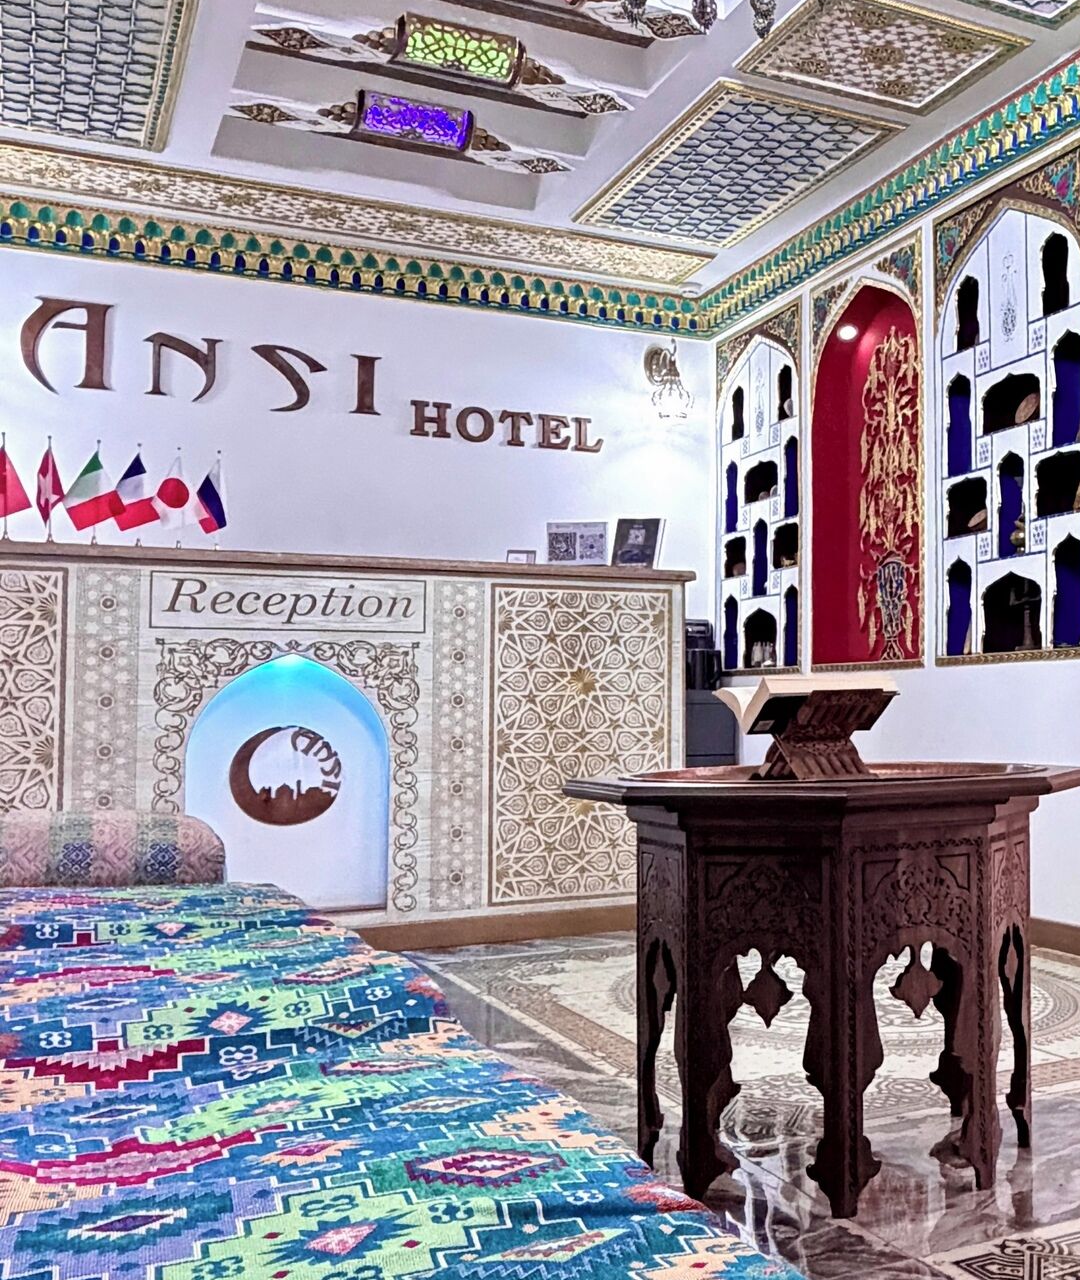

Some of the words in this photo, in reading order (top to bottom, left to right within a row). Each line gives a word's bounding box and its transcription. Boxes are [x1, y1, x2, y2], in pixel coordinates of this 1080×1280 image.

[20, 295, 382, 415] ANSI
[410, 400, 604, 453] HOTEL
[161, 577, 416, 625] Reception
[290, 725, 342, 792] ANSI
